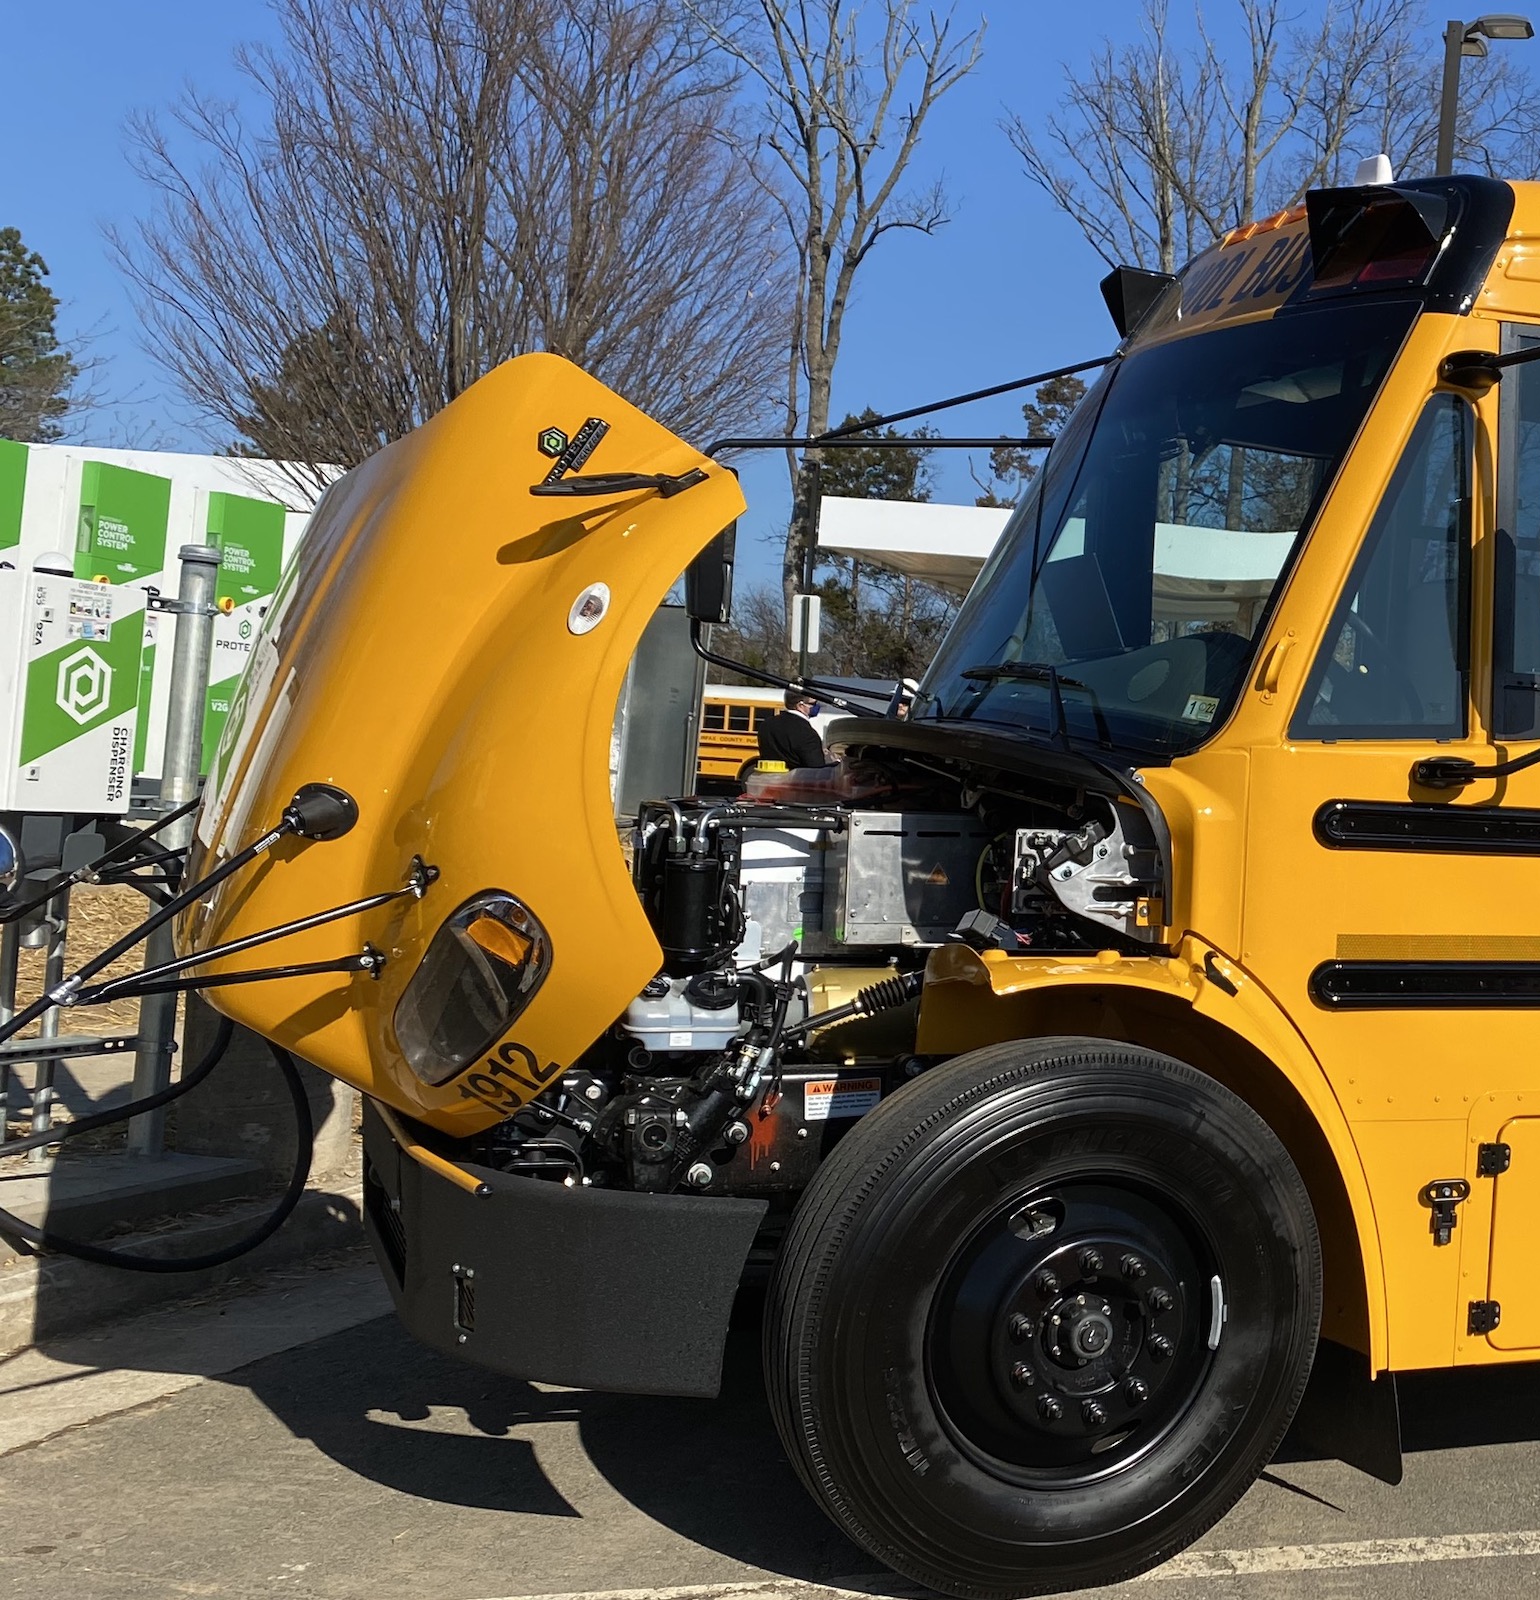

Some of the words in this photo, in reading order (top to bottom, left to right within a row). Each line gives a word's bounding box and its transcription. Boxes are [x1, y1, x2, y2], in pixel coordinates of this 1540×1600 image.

[98, 520, 128, 534] POWER
[97, 529, 136, 544] CONTROL
[96, 537, 128, 551] SYSTEM
[223, 546, 250, 558] POWER
[222, 562, 250, 574] SYSTEM
[223, 554, 256, 568] CONTROL
[34, 622, 44, 646] V2G
[215, 639, 251, 652] PROTE
[211, 702, 229, 712] V2G
[1190, 701, 1197, 715] 1
[106, 727, 120, 802] DISPENSER
[115, 728, 129, 799] CHARGING
[457, 1042, 561, 1115] 1912
[822, 1081, 873, 1092] WARNING
